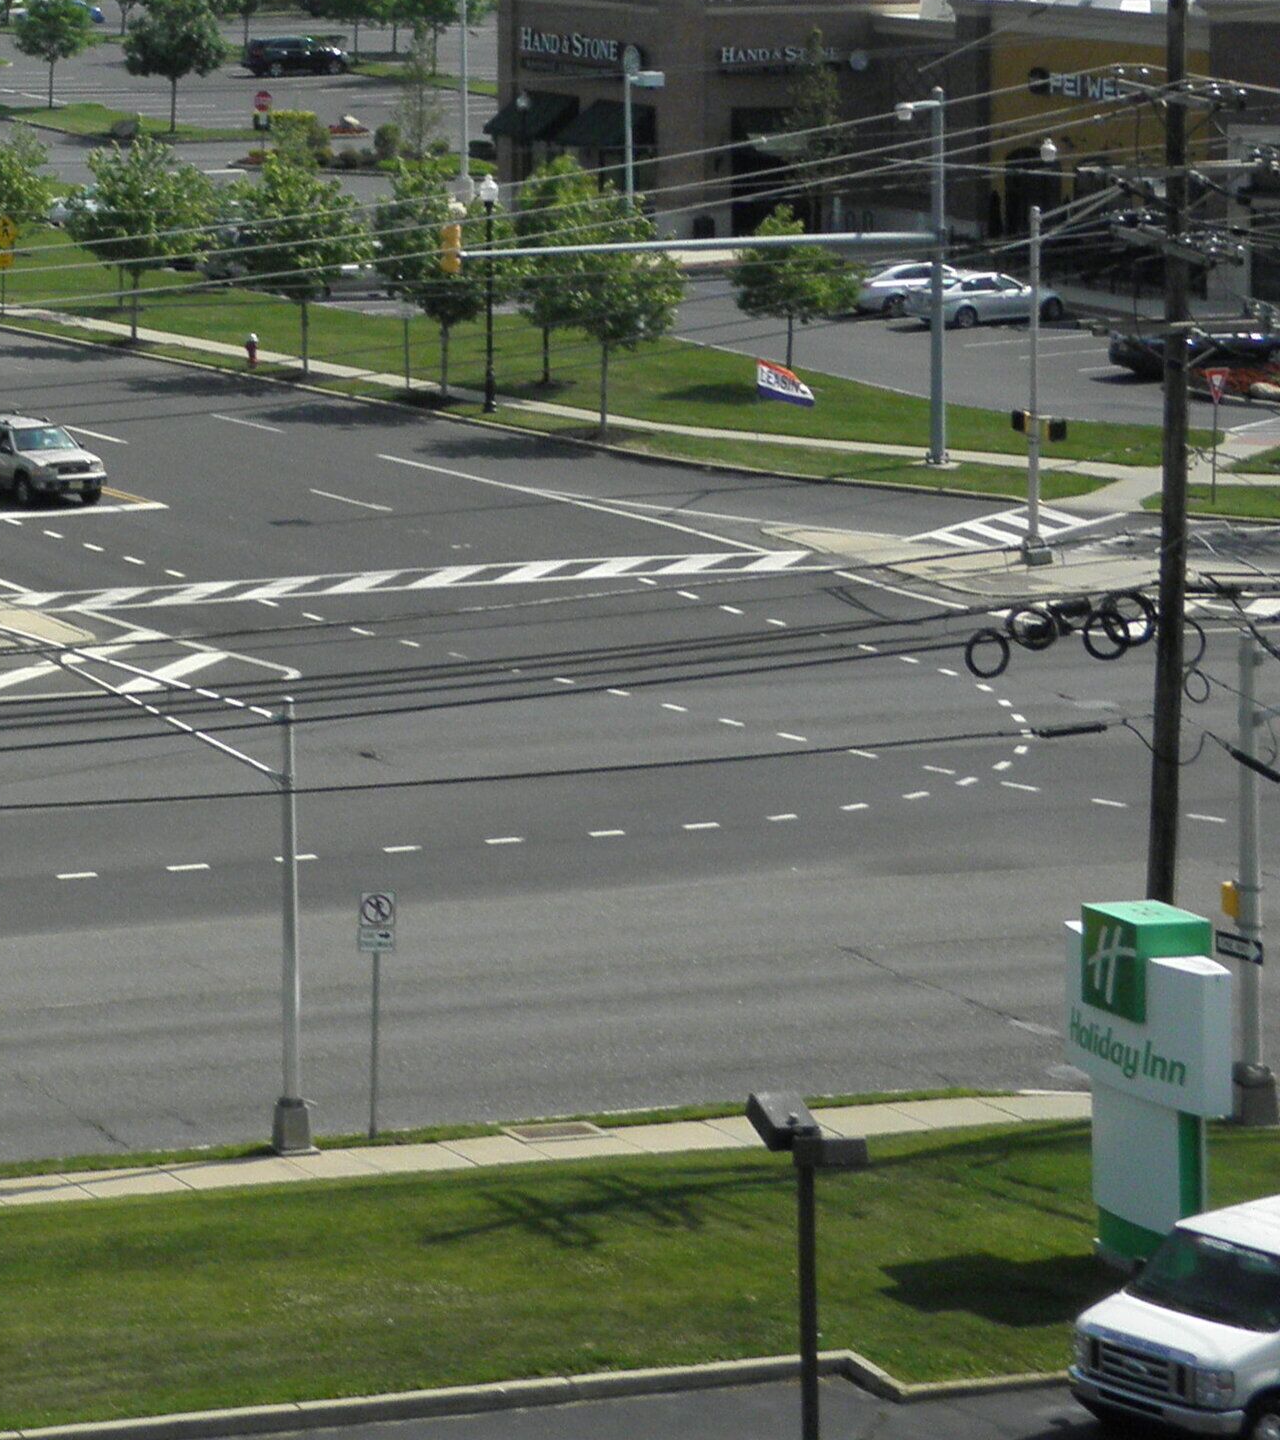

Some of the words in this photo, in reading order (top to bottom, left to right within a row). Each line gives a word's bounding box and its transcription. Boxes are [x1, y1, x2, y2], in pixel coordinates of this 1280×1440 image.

[521, 27, 560, 53] HAND
[572, 33, 619, 60] STONE
[721, 46, 770, 62] HAND
[784, 46, 840, 62] STNE
[1049, 73, 1081, 97] PEI
[1070, 1006, 1139, 1079] Holiday
[1142, 1040, 1186, 1088] Inn
